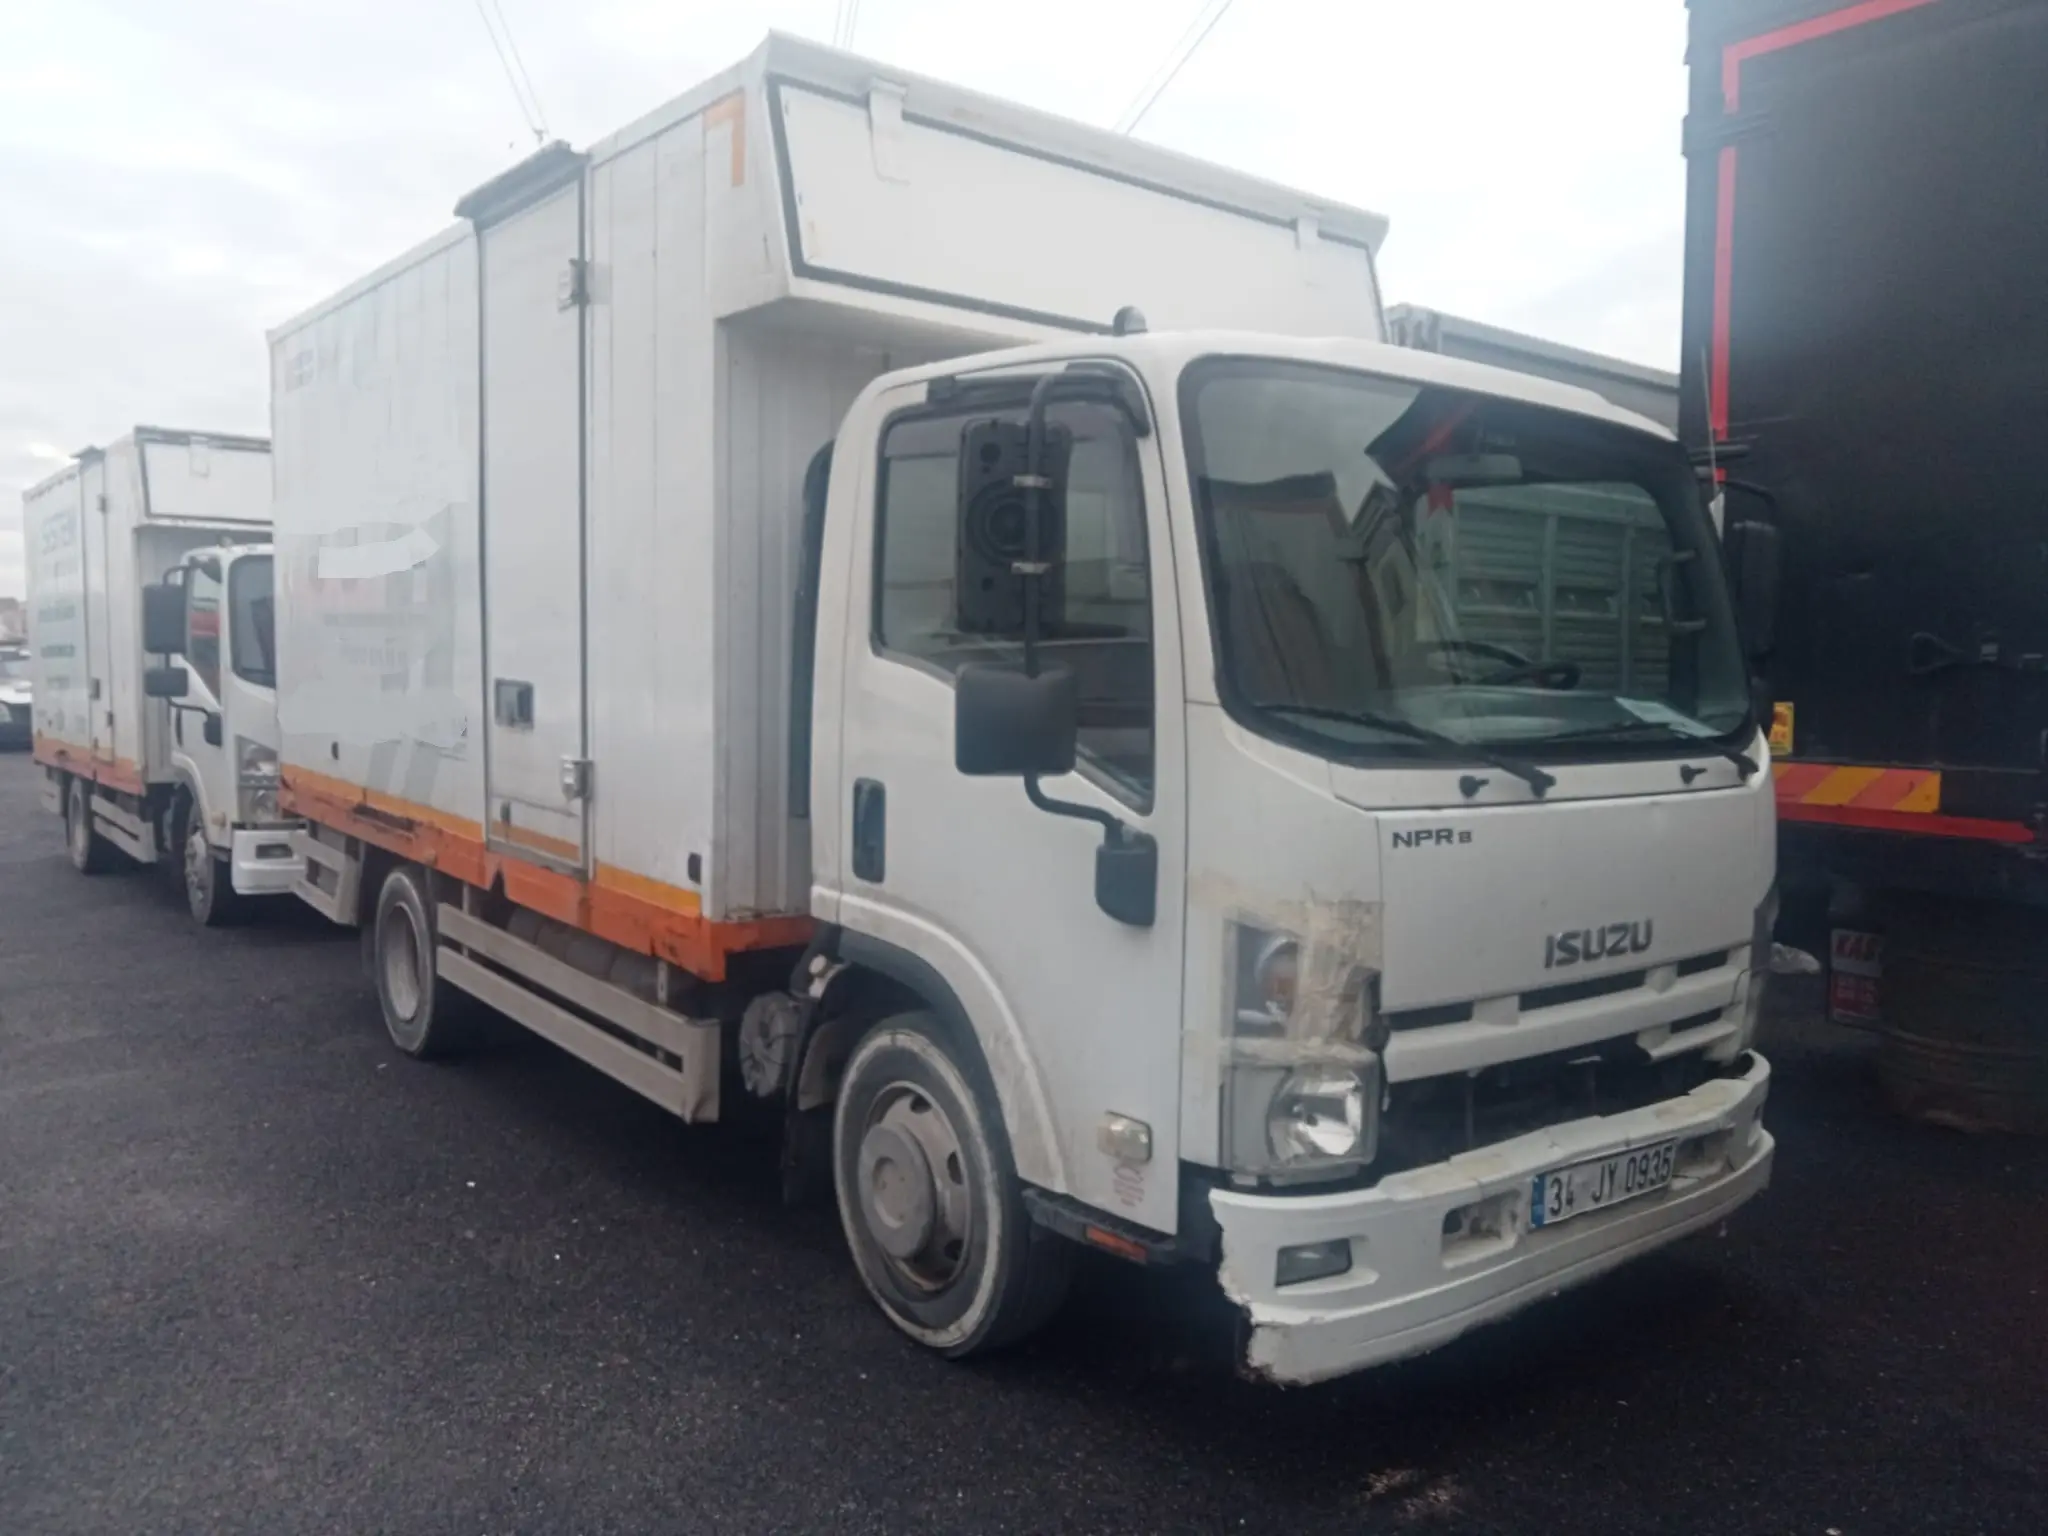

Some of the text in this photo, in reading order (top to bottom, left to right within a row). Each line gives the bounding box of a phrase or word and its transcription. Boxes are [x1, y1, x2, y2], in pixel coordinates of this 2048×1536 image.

[1392, 829, 1454, 848] NPR
[1545, 919, 1653, 969] ISUZU
[1550, 1145, 1673, 1216] 34 JY 0935
